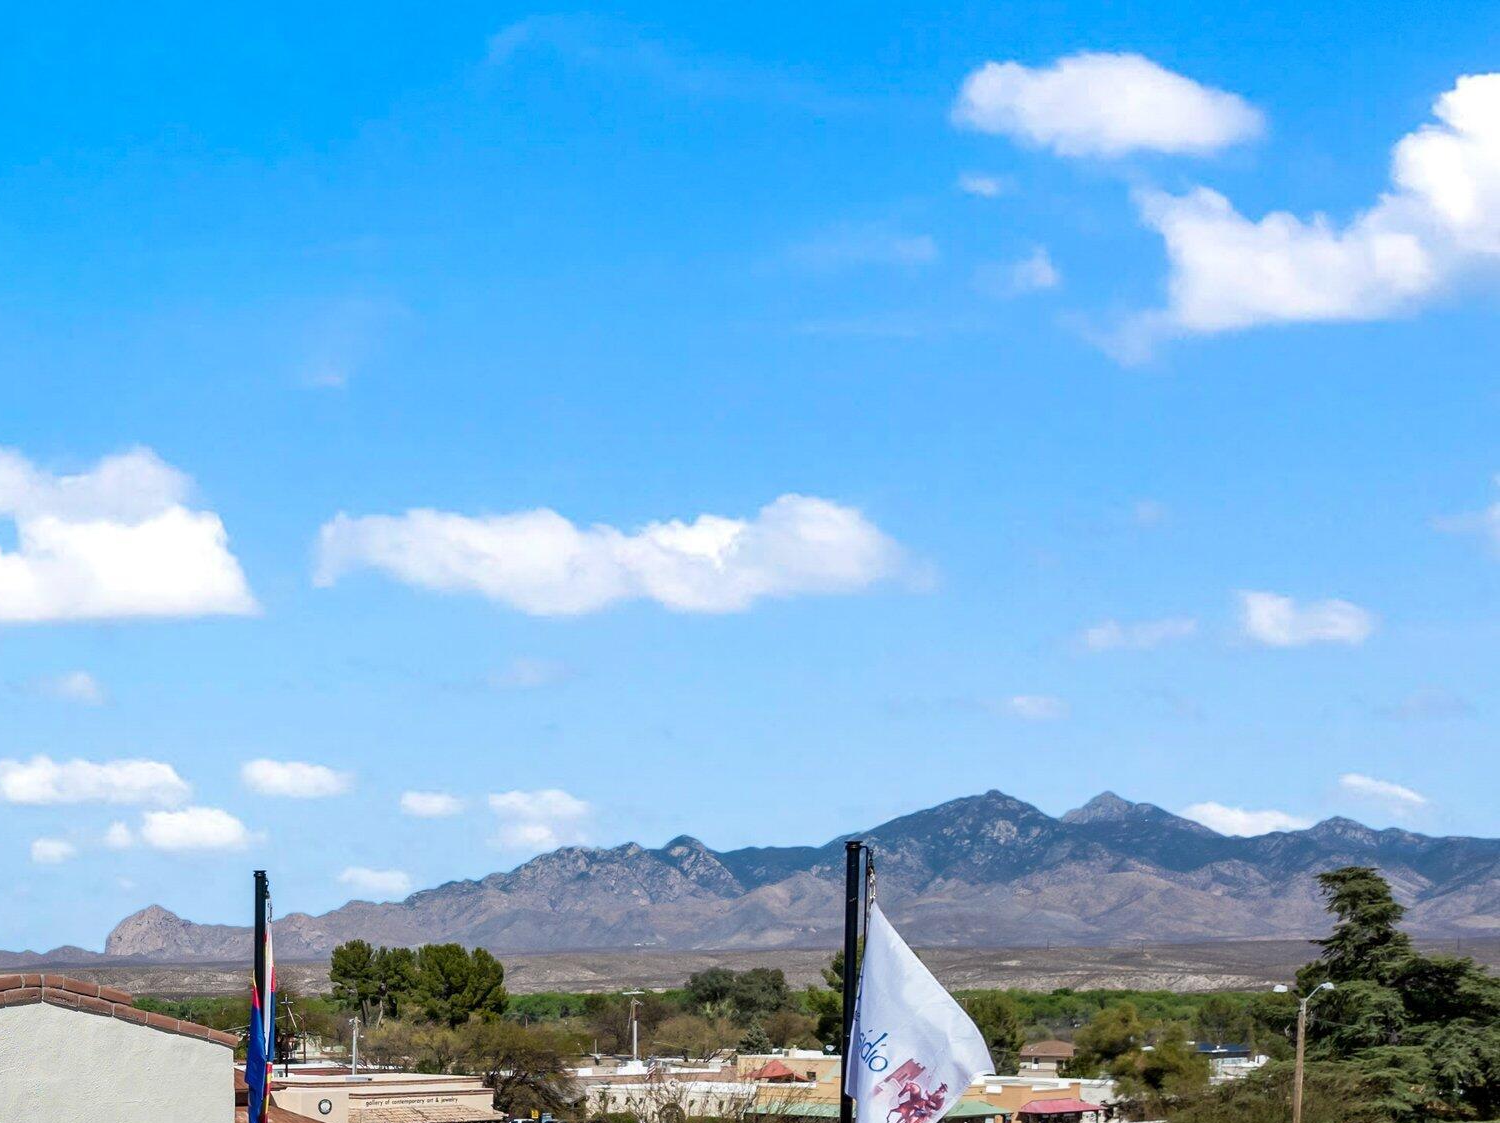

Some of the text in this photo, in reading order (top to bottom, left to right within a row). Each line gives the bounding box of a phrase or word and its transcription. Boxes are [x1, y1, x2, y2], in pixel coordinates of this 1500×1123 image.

[366, 1098, 383, 1107] gallery
[392, 1096, 425, 1106] contemporary
[440, 1095, 458, 1104] jewelry
